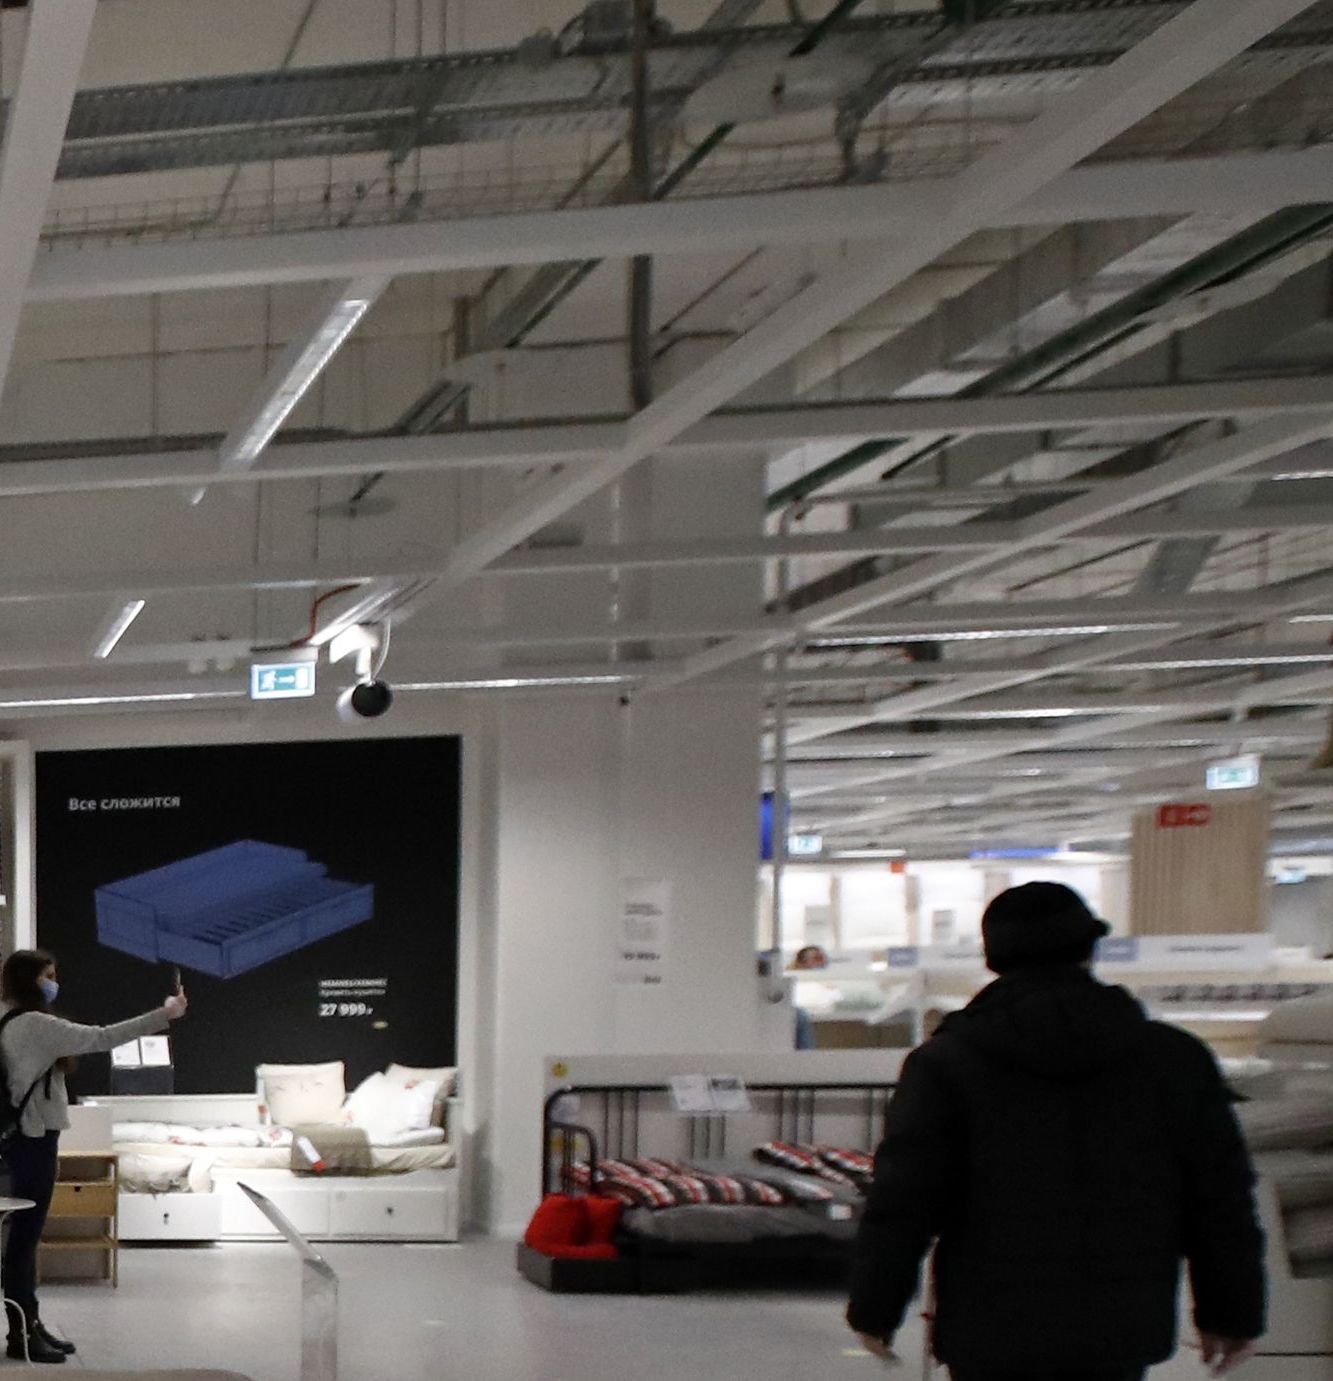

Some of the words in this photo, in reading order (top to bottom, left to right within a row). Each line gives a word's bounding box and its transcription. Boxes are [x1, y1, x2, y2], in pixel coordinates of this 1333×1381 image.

[69, 797, 97, 811] Все
[100, 795, 181, 810] сложится
[319, 1002, 337, 1017] 27
